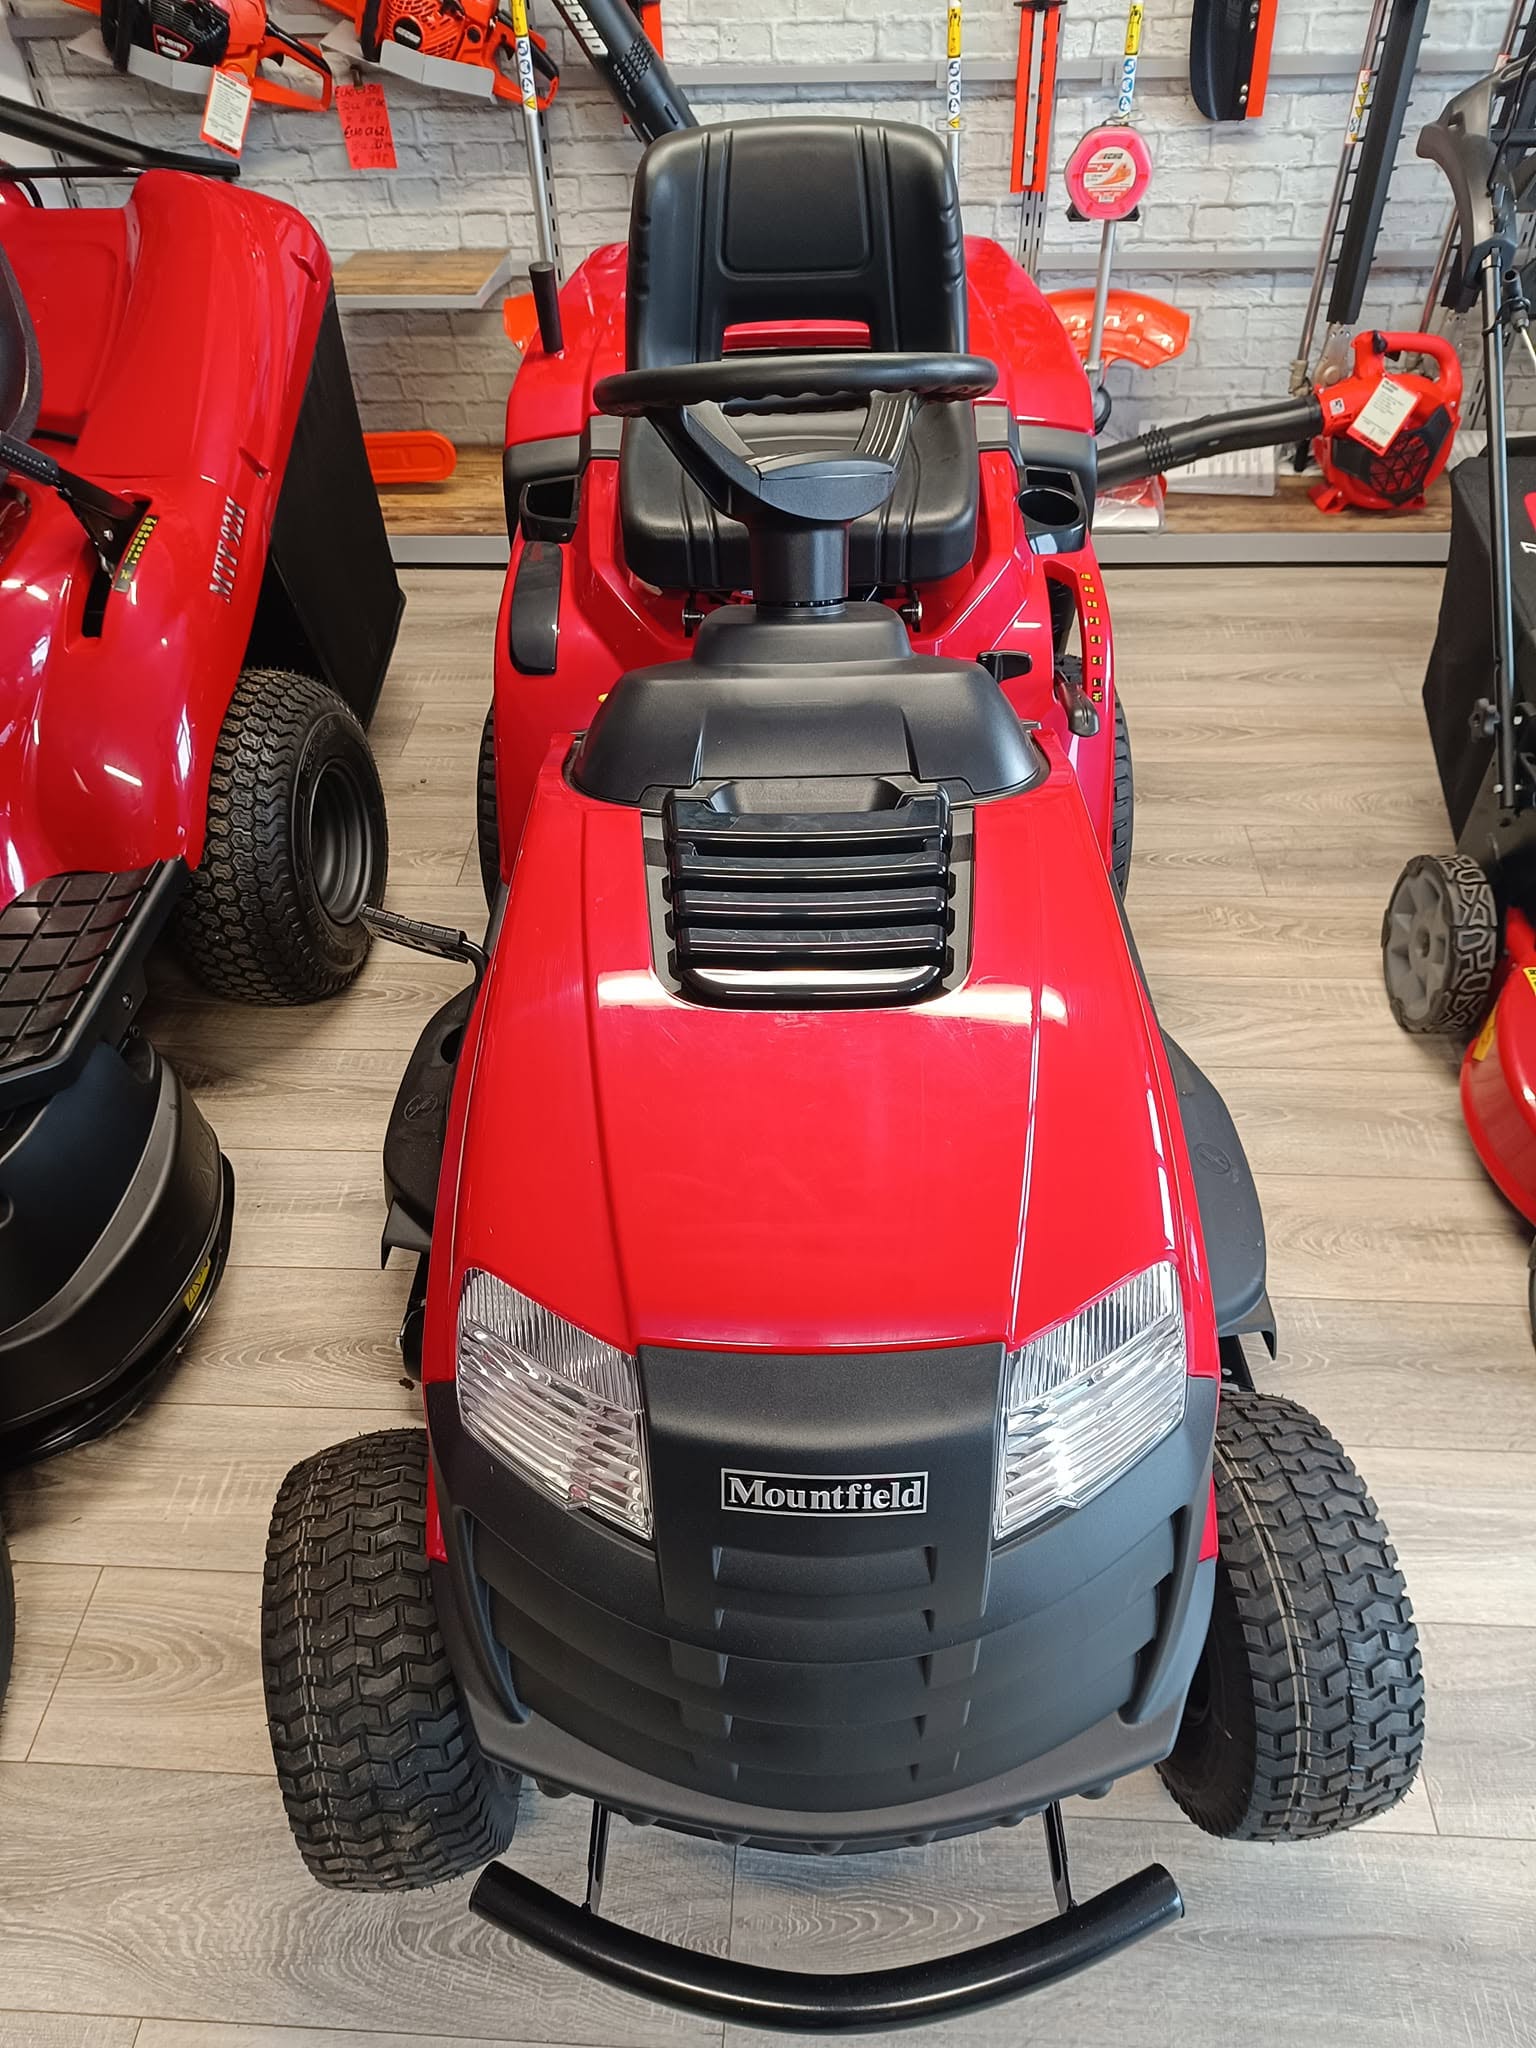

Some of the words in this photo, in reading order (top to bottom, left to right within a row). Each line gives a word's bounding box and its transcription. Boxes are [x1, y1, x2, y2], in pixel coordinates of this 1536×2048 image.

[220, 496, 246, 547] 92H
[209, 540, 238, 604] MTF
[727, 1476, 923, 1510] Mountfield
